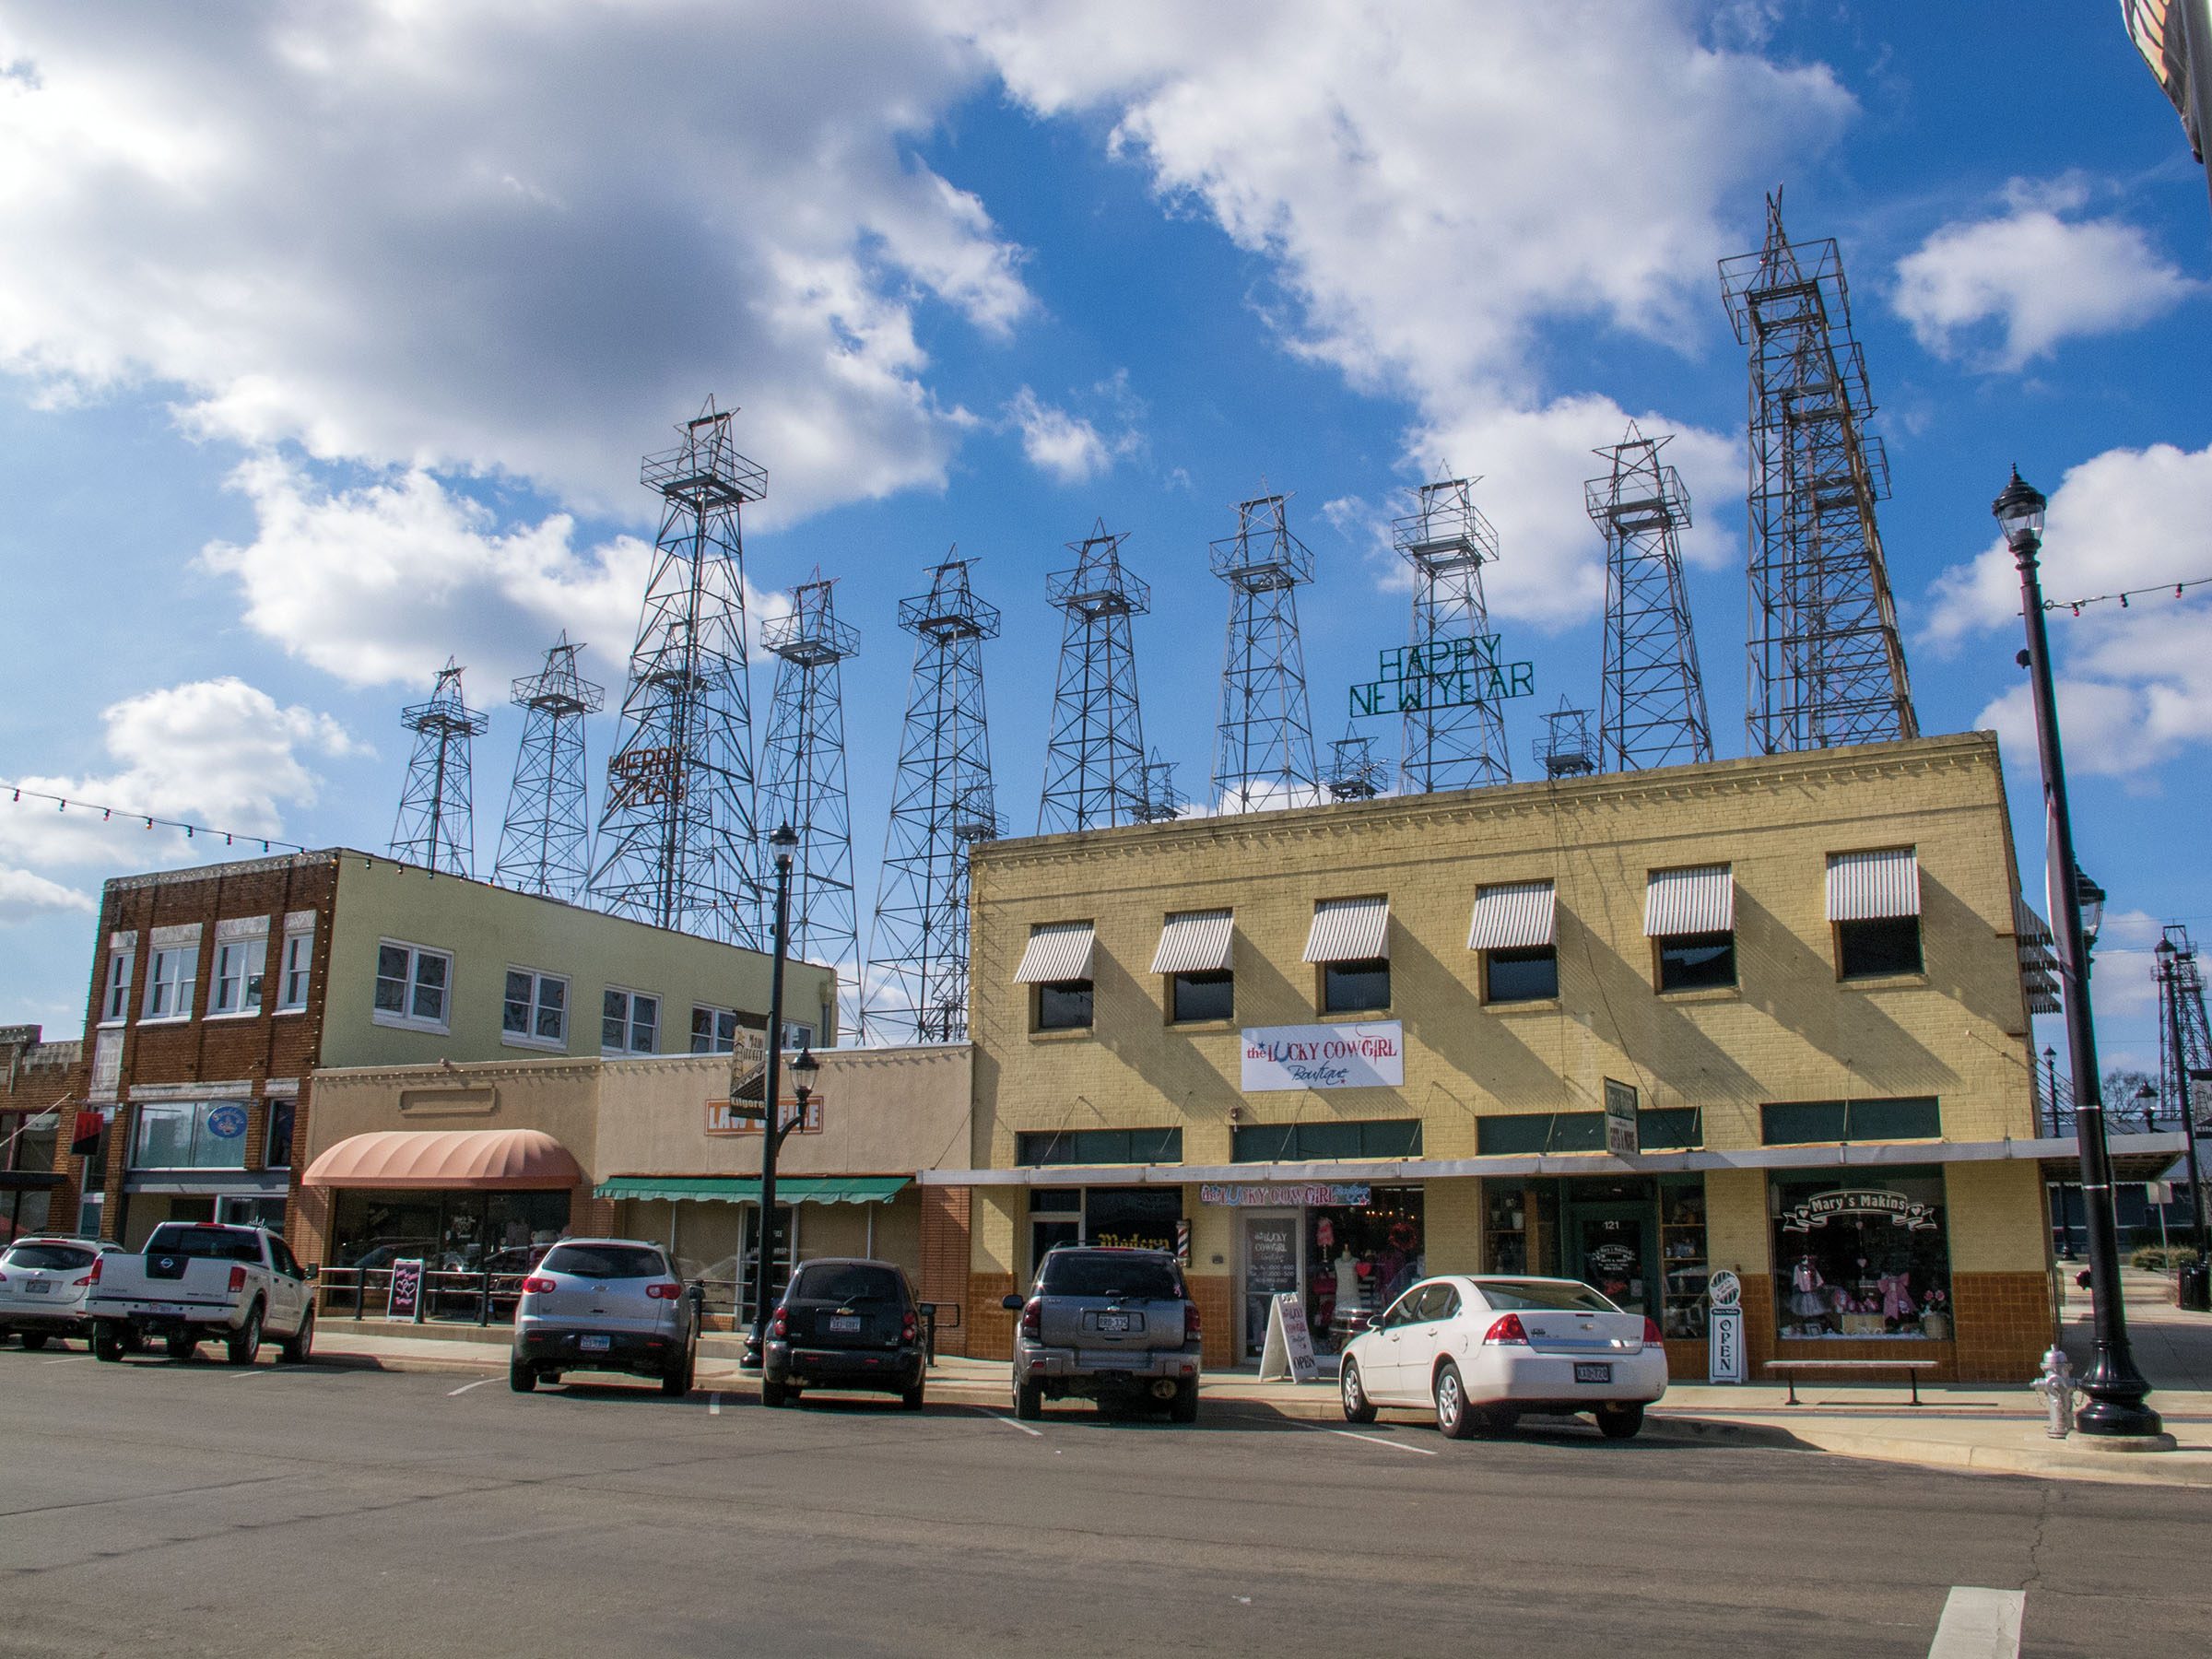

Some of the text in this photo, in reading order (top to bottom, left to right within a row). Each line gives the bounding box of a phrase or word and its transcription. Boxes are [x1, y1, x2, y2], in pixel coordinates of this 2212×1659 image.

[1380, 634, 1500, 682] HAPPY
[1350, 662, 1534, 717] NEW YEAR
[1246, 1038, 1398, 1065] the LUCKY COWGIRL
[1287, 1061, 1349, 1086] Boutique
[731, 1096, 766, 1109] Kilgore
[1219, 1184, 1269, 1206] LUCKY
[1270, 1183, 1336, 1206] COWGIRL
[1811, 1194, 1906, 1212] Mary's Makins
[1604, 1220, 1619, 1230] 121
[1720, 1319, 1732, 1371] OPEN
[1293, 1355, 1316, 1371] OPEN
